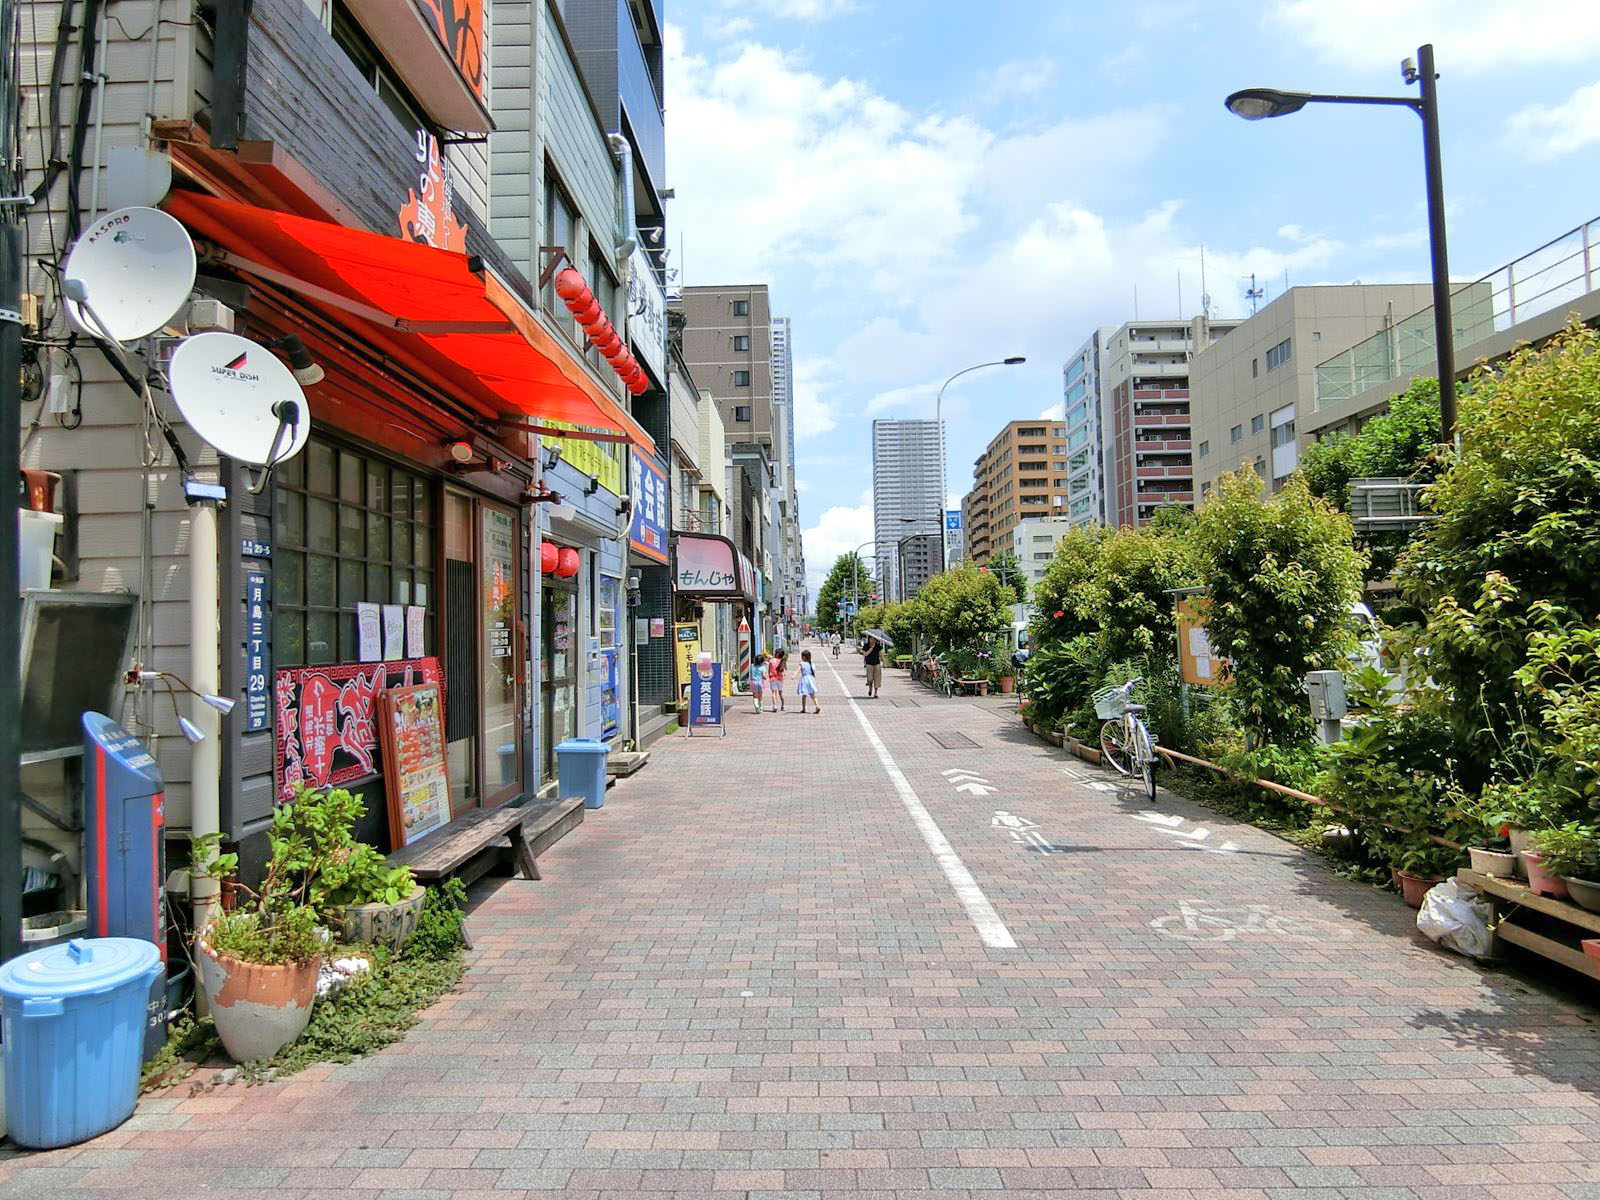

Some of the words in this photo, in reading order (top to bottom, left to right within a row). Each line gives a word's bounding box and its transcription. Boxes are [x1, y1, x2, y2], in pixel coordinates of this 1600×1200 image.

[211, 366, 237, 377] SUPER
[255, 544, 271, 555] 29-5
[250, 674, 265, 691] 29
[700, 681, 712, 716] 英会話
[253, 717, 263, 728] 29
[305, 704, 315, 751] 北海道
[313, 680, 327, 775] 十勝ポーク
[325, 709, 335, 737] 使用
